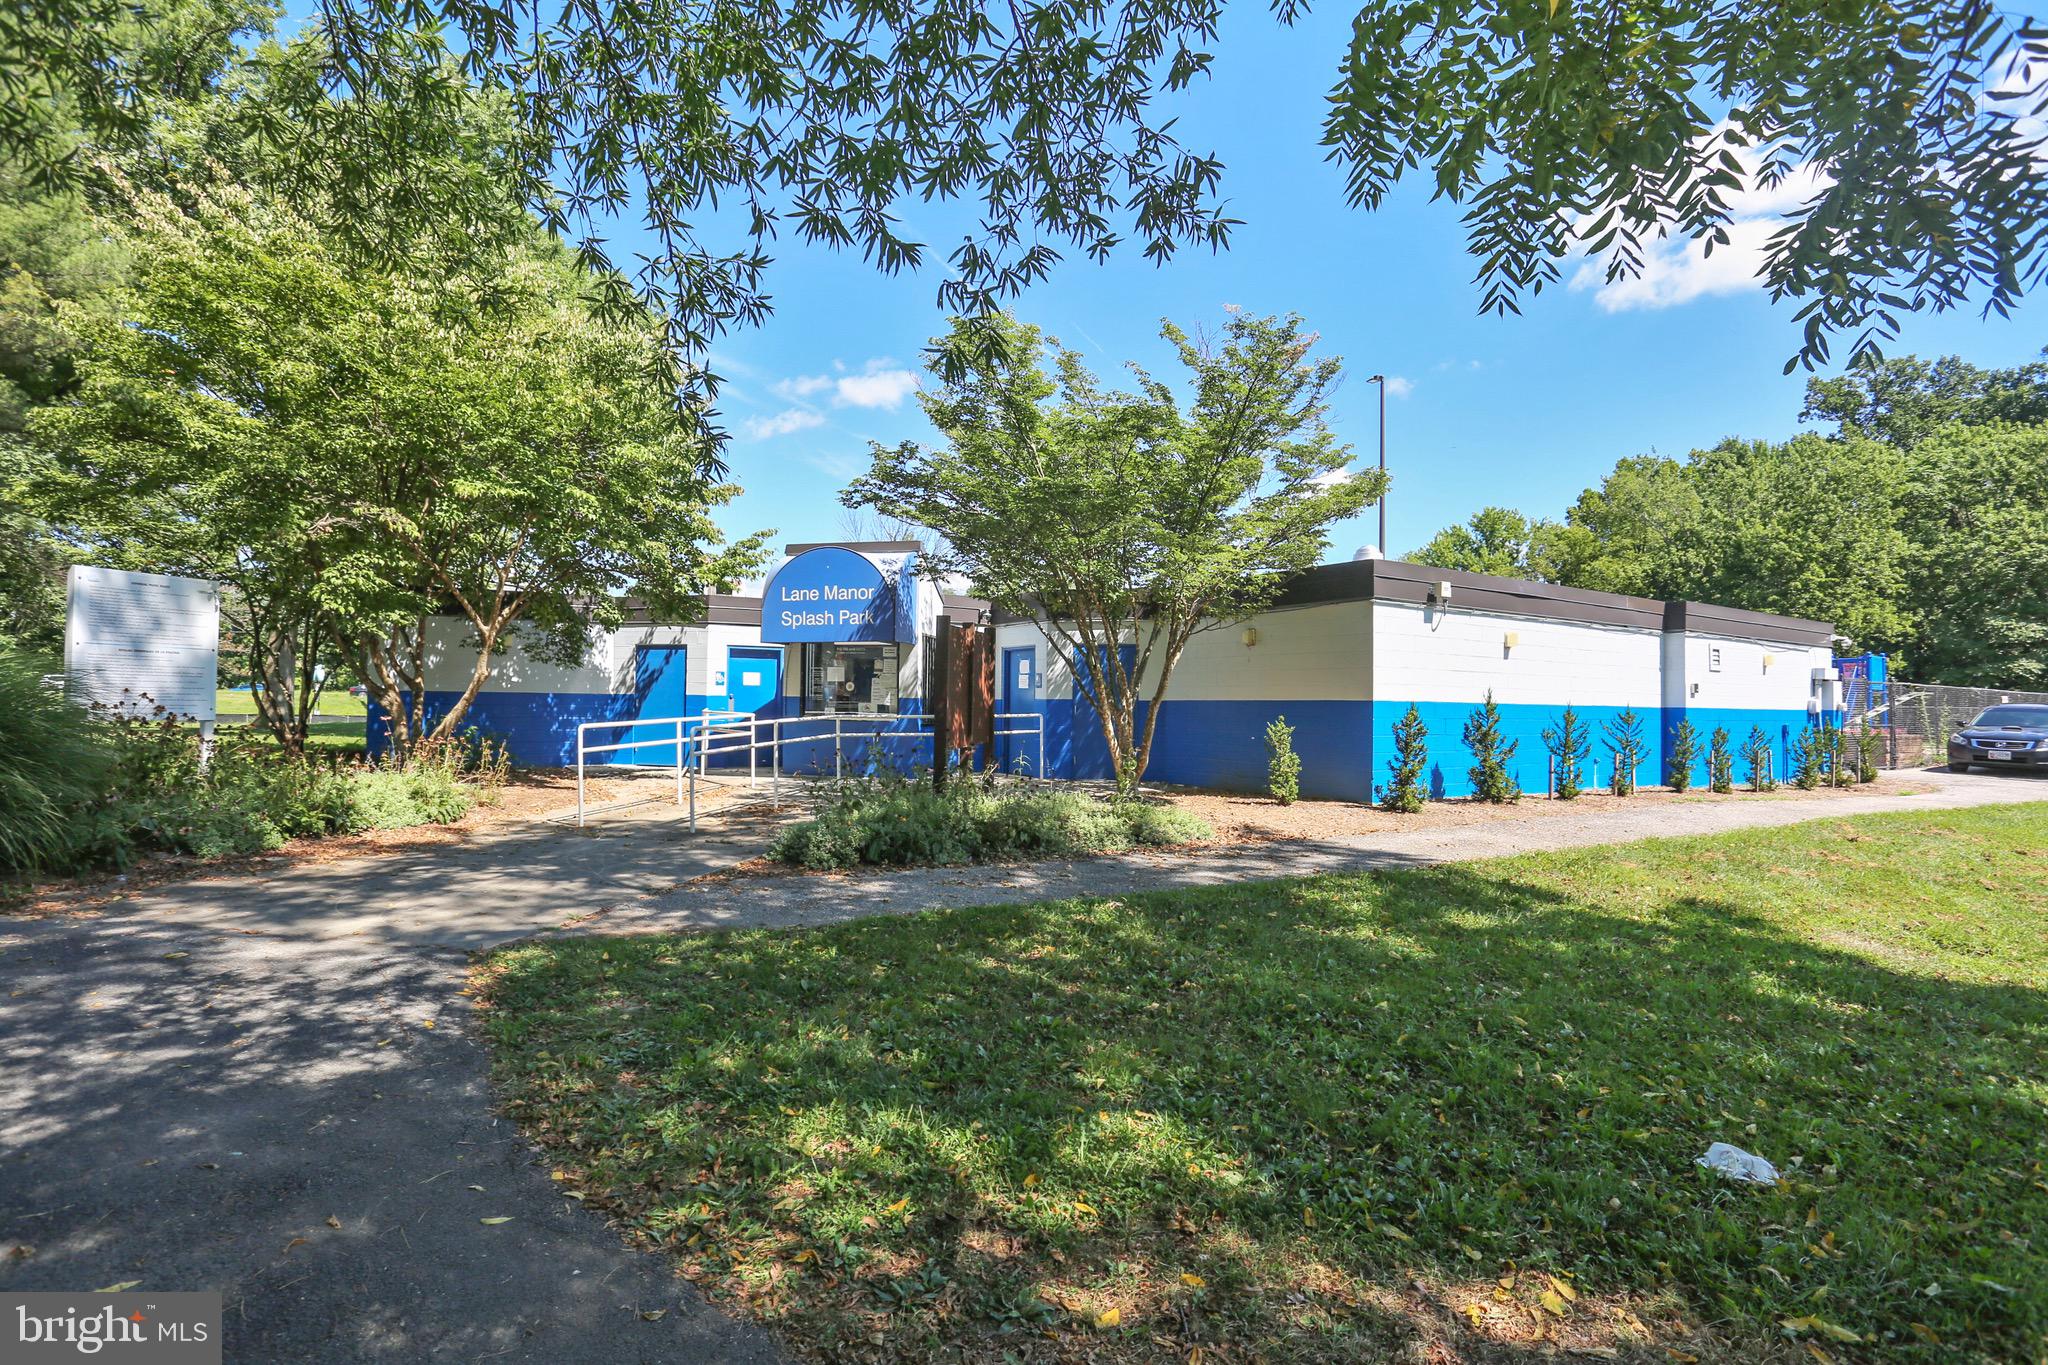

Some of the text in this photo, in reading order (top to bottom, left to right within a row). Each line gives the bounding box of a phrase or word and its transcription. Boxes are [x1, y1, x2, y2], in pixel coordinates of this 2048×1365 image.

[781, 584, 875, 602] Lane Manor
[781, 609, 874, 630] Splash Park
